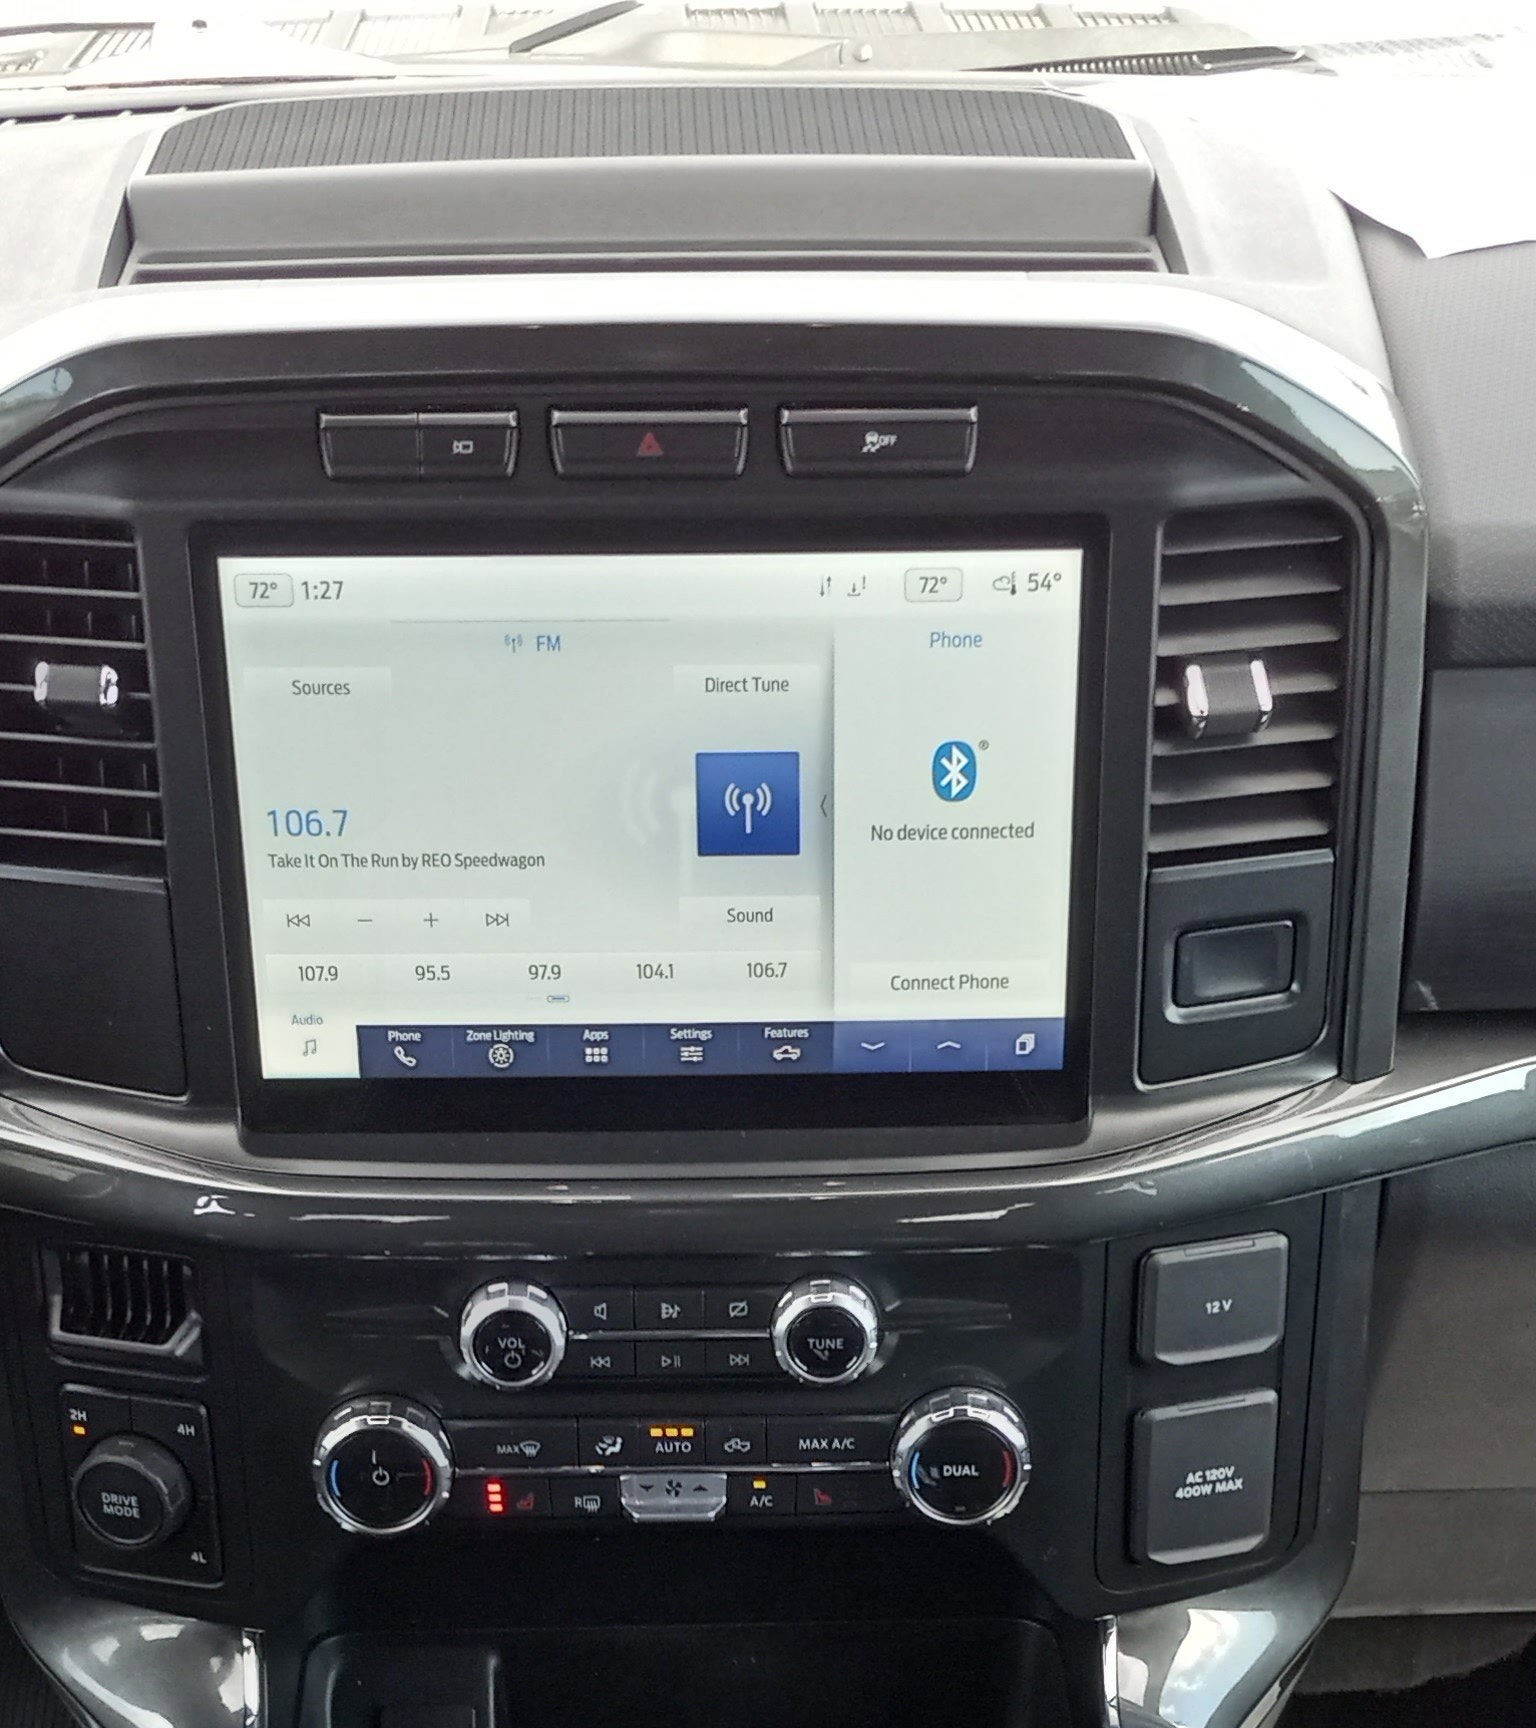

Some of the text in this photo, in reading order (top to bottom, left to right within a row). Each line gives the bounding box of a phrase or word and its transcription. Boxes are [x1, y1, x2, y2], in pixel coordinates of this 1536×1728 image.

[879, 435, 898, 447] OFF
[248, 580, 344, 600] 72° 1:27
[919, 576, 948, 594] 72°
[1027, 572, 1063, 593] 54°
[536, 635, 561, 652] FM
[929, 632, 983, 649] Phone
[291, 679, 351, 697] Sources
[704, 677, 789, 694] Direct Tune
[267, 809, 348, 837] 106.7
[871, 822, 1035, 841] No device connected
[268, 852, 545, 871] Take It On The Run by REO Speedwagon
[726, 907, 773, 924] Sound
[298, 965, 339, 982] 107.9
[414, 965, 451, 981] 95.5
[528, 964, 562, 981] 97.9
[636, 963, 674, 980] 104.1
[746, 963, 787, 978] 106.7
[890, 974, 1009, 991] Connect Phone
[291, 1014, 323, 1026] Audio
[387, 1029, 422, 1044] Phone
[465, 1029, 535, 1044] Zone Lighting
[582, 1028, 609, 1043] Apps
[669, 1027, 712, 1043] Settings
[764, 1027, 809, 1040] Features
[1205, 1301, 1220, 1315] 12
[497, 1337, 525, 1350] VOL
[807, 1337, 844, 1350] TUNE
[177, 1424, 195, 1436] 4H
[497, 1444, 519, 1455] MAX
[655, 1441, 692, 1453] AUTO
[799, 1437, 855, 1450] MAX A/C
[943, 1465, 979, 1477] DUAL
[1186, 1466, 1235, 1484] AC 120V
[1175, 1478, 1243, 1499] 400W MAX
[101, 1492, 138, 1507] DRIVE
[750, 1495, 773, 1508] A/C
[103, 1505, 140, 1519] MODE
[191, 1552, 206, 1564] 4L
